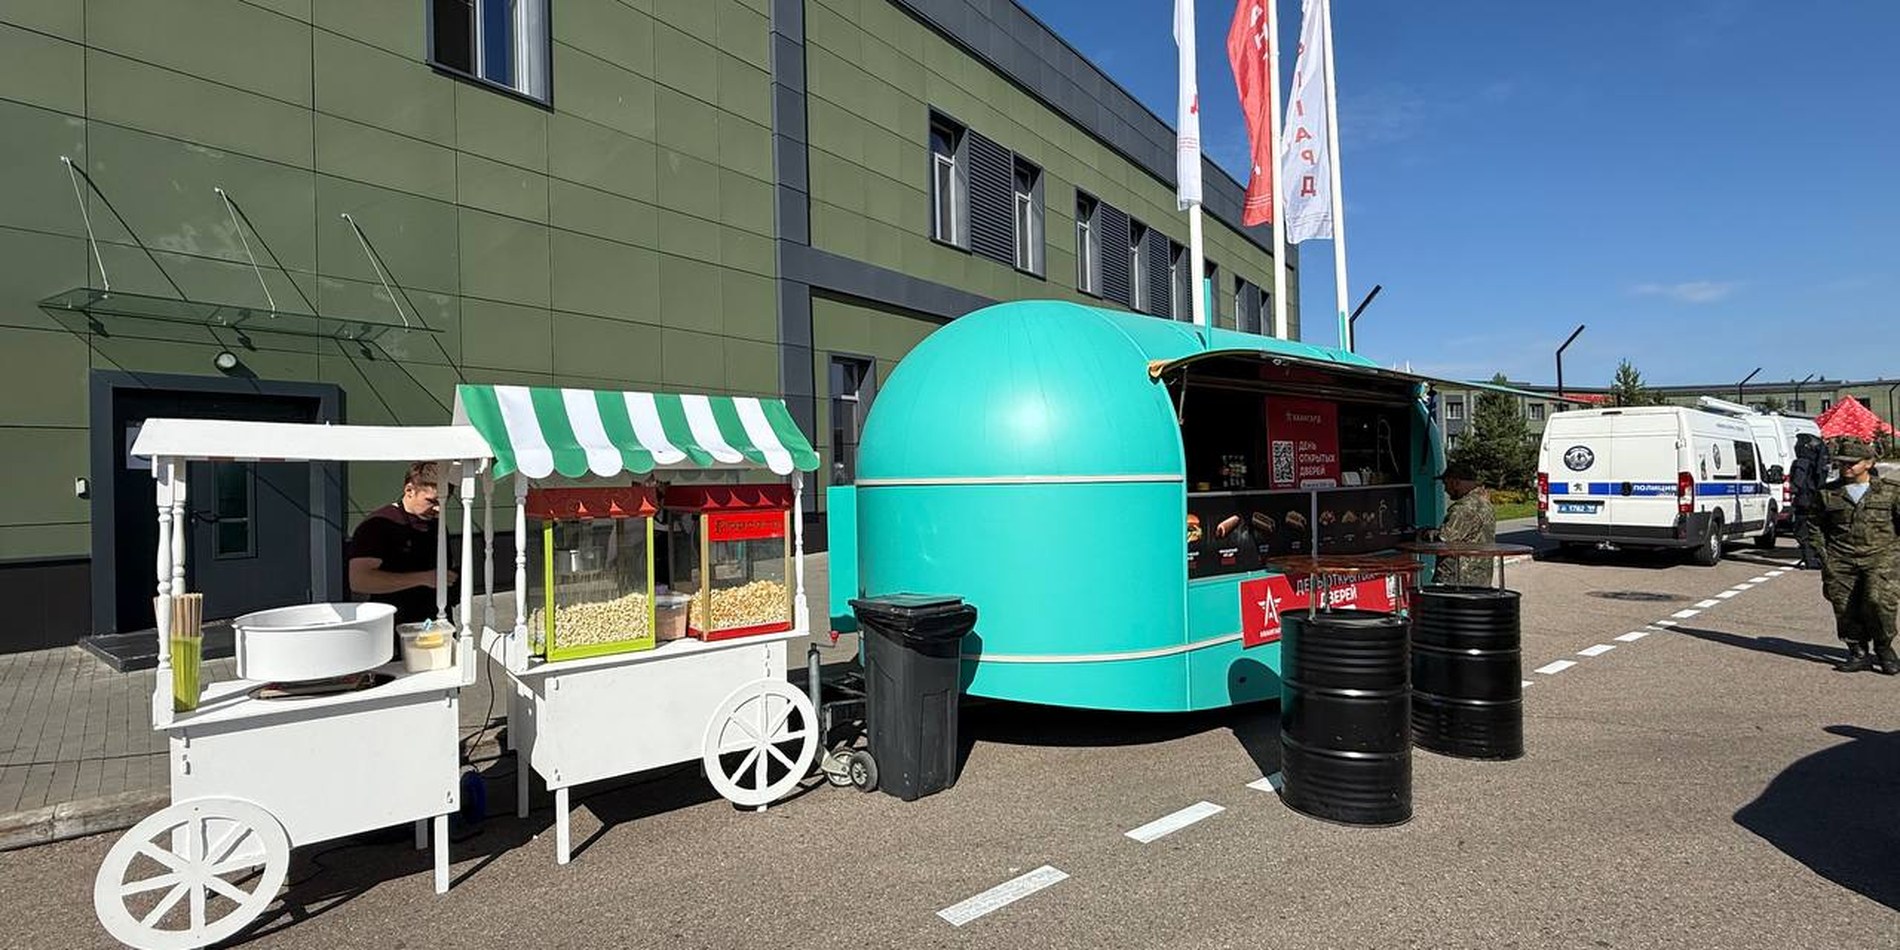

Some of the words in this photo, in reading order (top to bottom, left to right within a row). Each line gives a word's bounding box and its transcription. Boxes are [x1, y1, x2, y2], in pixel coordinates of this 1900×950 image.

[1299, 441, 1317, 452] ДЕНЬ
[1299, 453, 1336, 463] ОТКРЫТЫХ
[1299, 465, 1326, 478] ДВЕРЕЙ
[1633, 484, 1677, 492] ПОЛИЦИЯ
[1296, 577, 1324, 596] ДЕЬ
